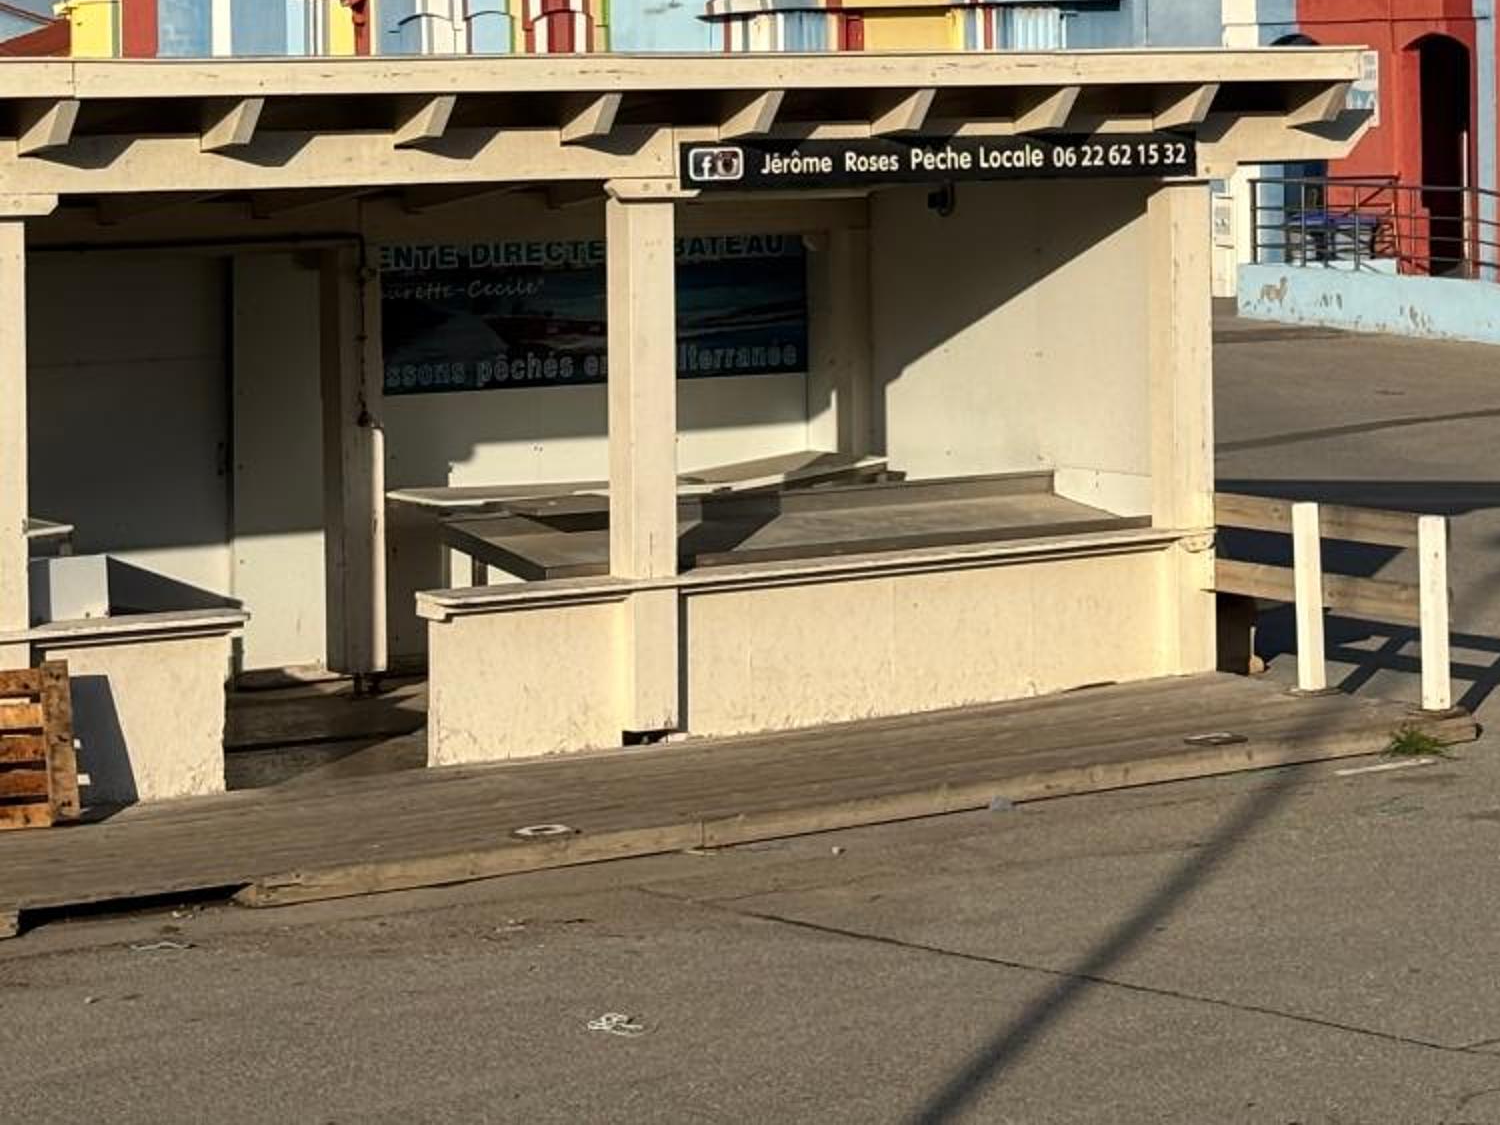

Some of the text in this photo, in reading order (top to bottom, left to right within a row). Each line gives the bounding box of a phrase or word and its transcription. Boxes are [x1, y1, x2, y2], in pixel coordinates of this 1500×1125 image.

[760, 148, 832, 174] Jérôme
[845, 151, 899, 172] Roses
[979, 143, 1044, 168] Locale
[1053, 146, 1077, 168] 06
[1081, 145, 1104, 166] 22
[1108, 144, 1132, 166] 62
[1137, 143, 1159, 165] 15
[1163, 143, 1186, 164] 32
[380, 245, 457, 271] ENTE
[468, 240, 605, 269] DIRECTE
